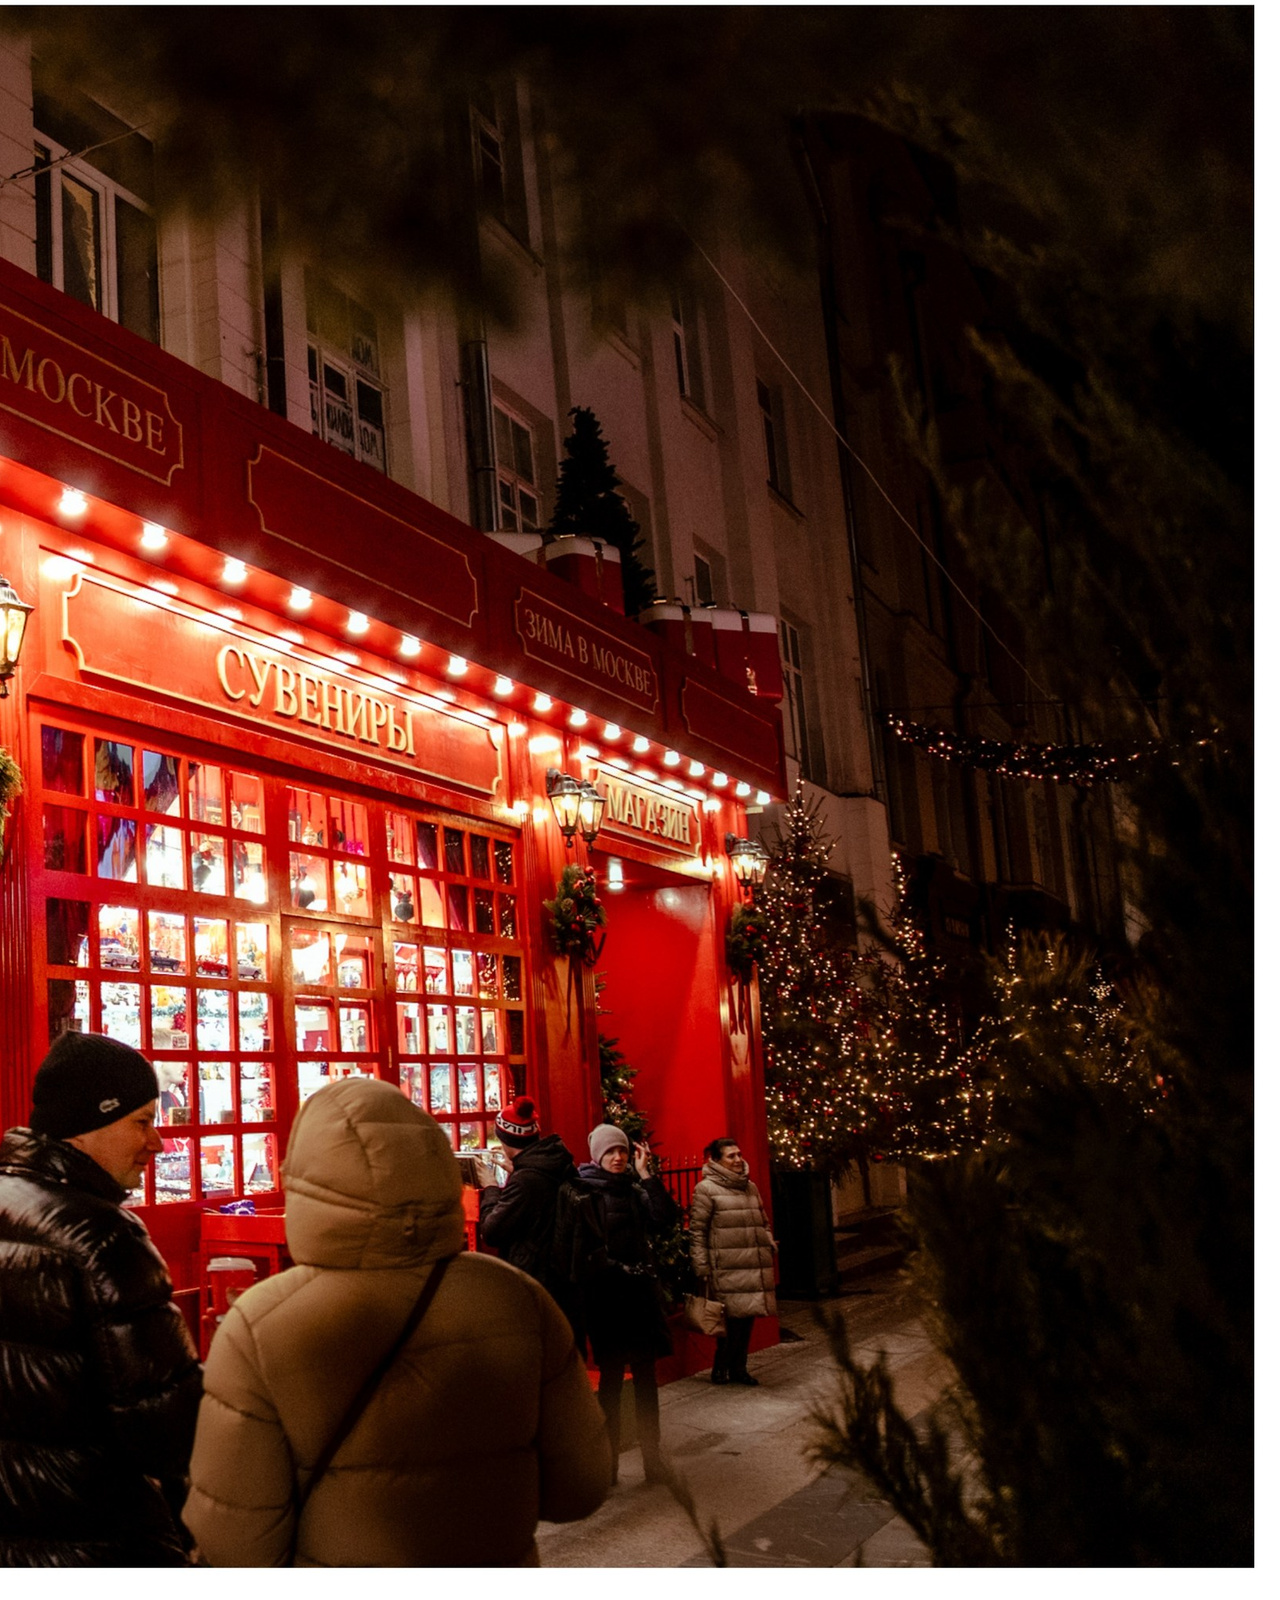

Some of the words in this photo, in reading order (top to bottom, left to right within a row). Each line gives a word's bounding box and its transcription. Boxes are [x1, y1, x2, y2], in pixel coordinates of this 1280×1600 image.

[0, 333, 167, 457] МОСКВЕ
[216, 645, 416, 757] СУВЕНИРЫ
[524, 608, 575, 658] ЗИМА
[578, 635, 589, 665] В
[592, 643, 653, 697] МОСКВЕ
[606, 784, 691, 844] МАГАЗИН
